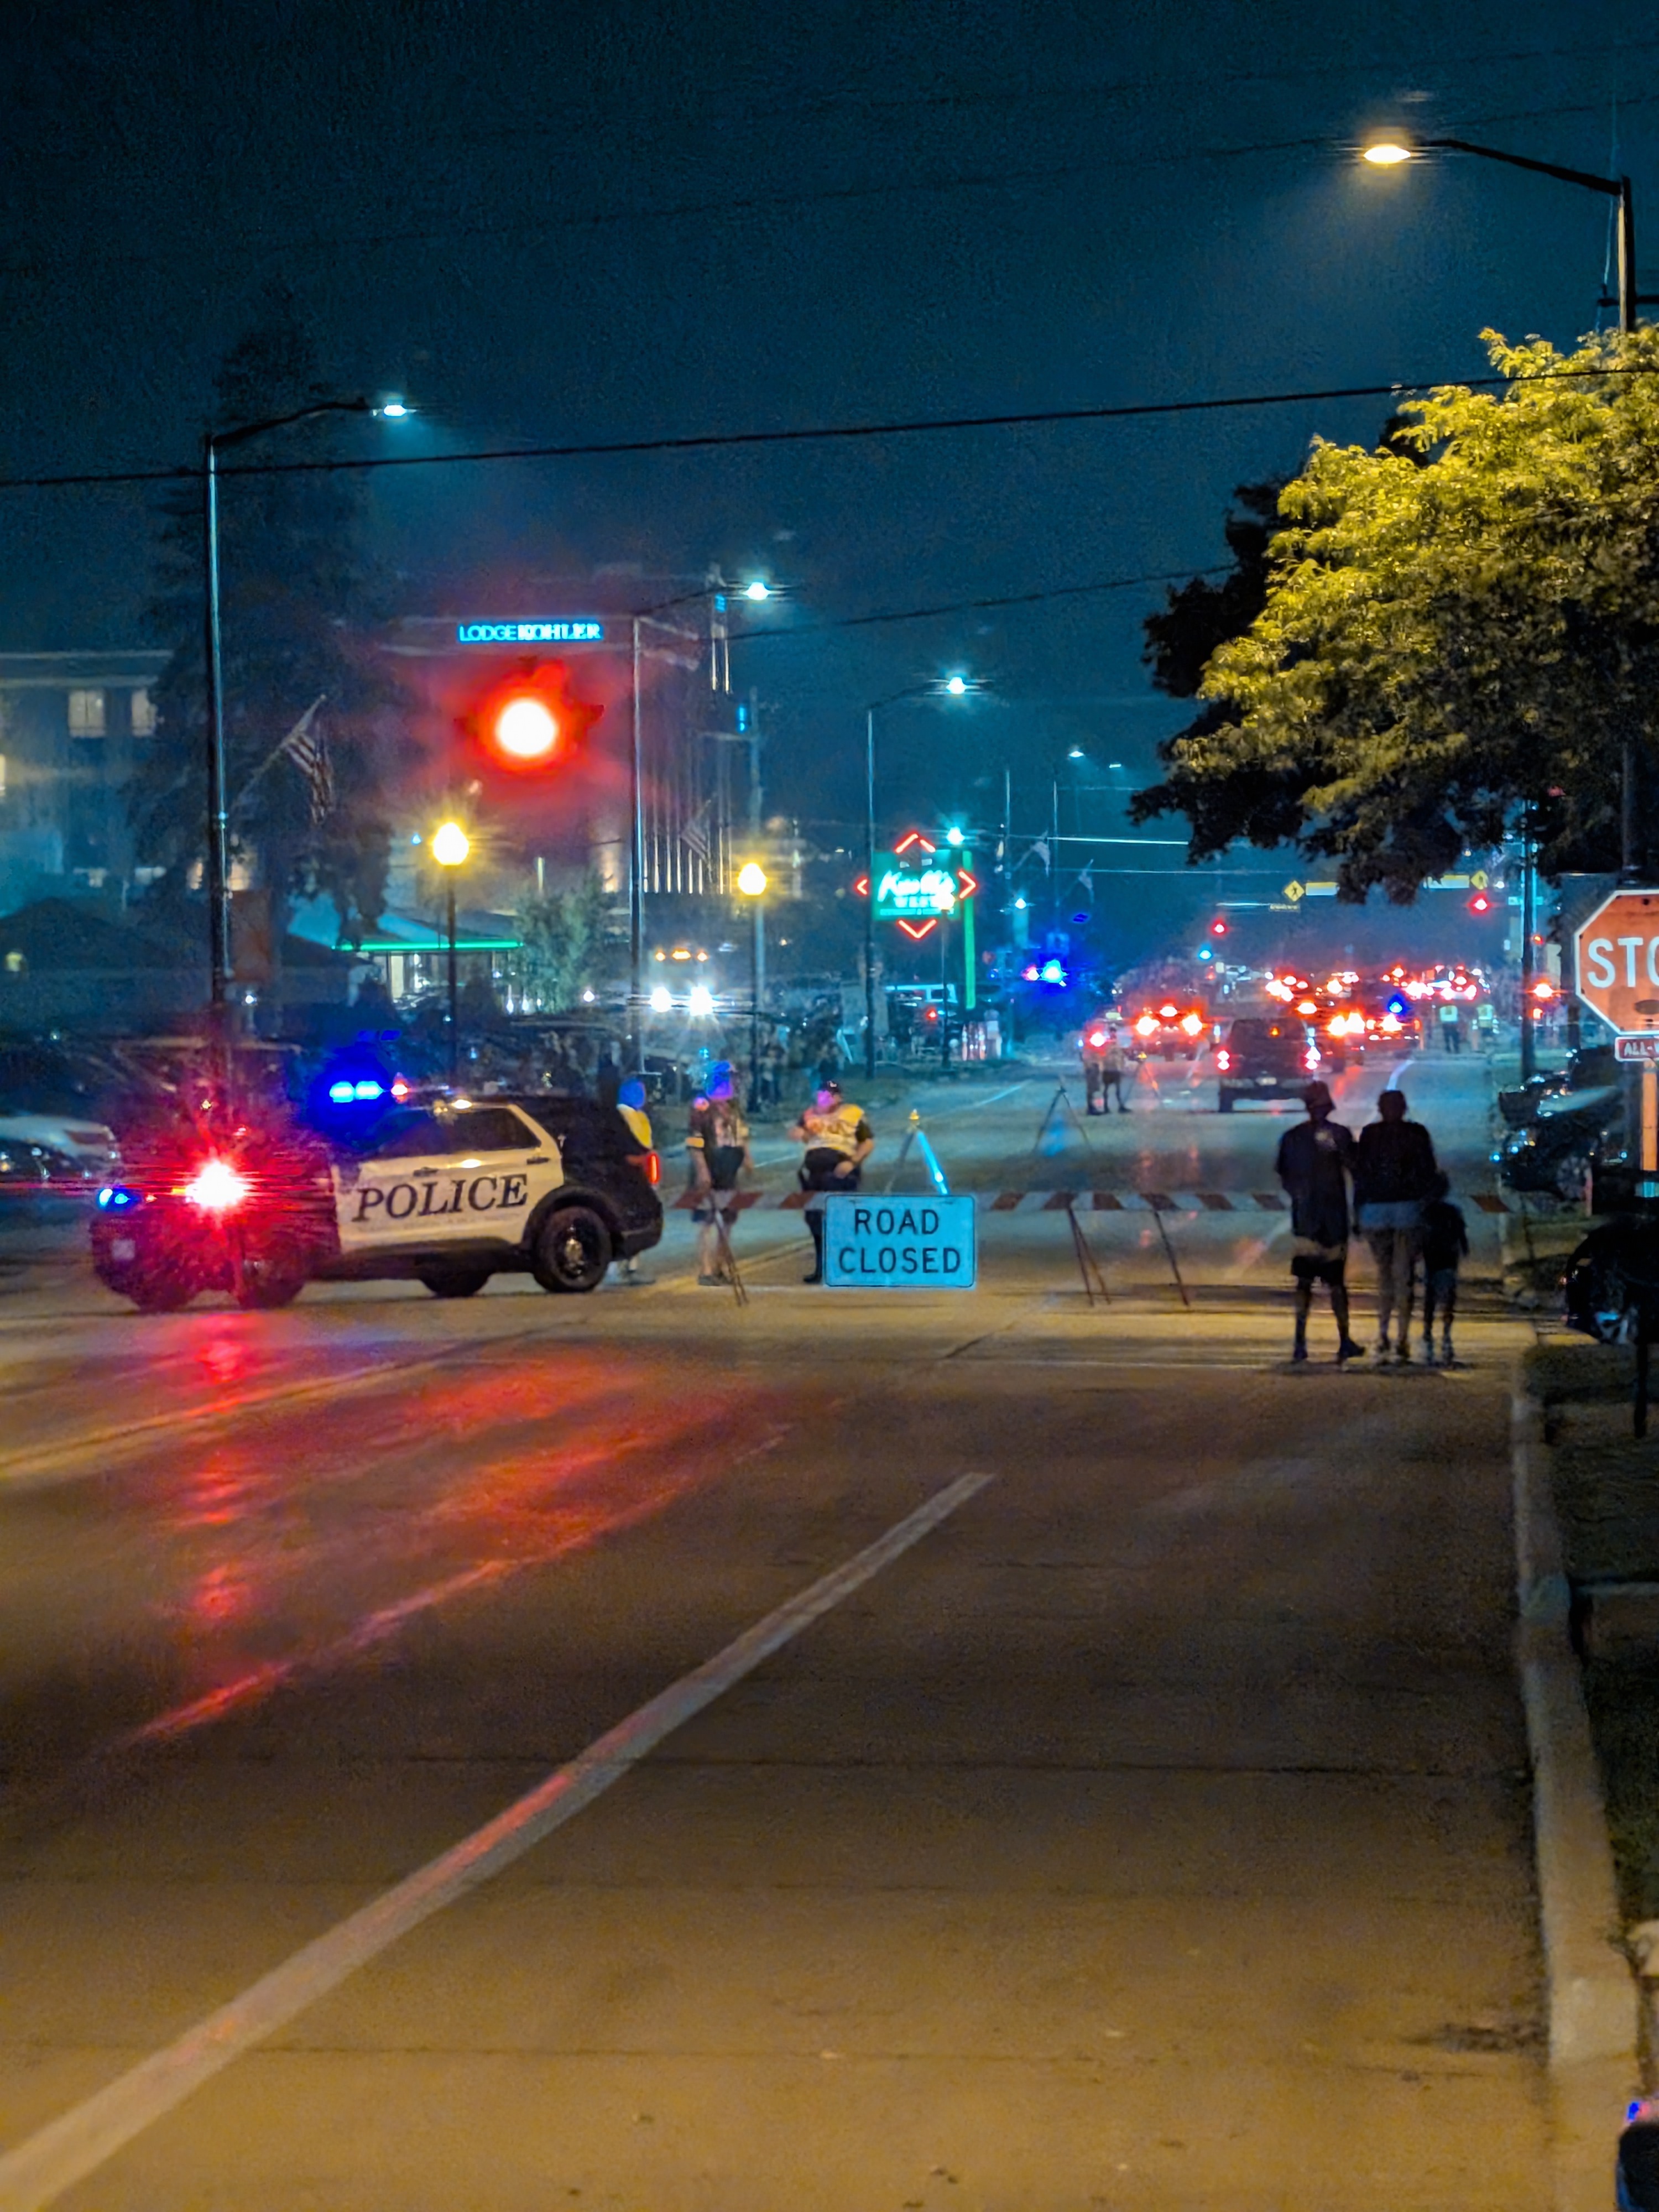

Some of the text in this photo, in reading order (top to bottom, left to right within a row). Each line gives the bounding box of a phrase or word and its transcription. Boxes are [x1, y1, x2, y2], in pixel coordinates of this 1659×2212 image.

[351, 1173, 528, 1222] POLICE
[854, 1208, 939, 1235] ROAD
[838, 1247, 961, 1274] CLOSED
